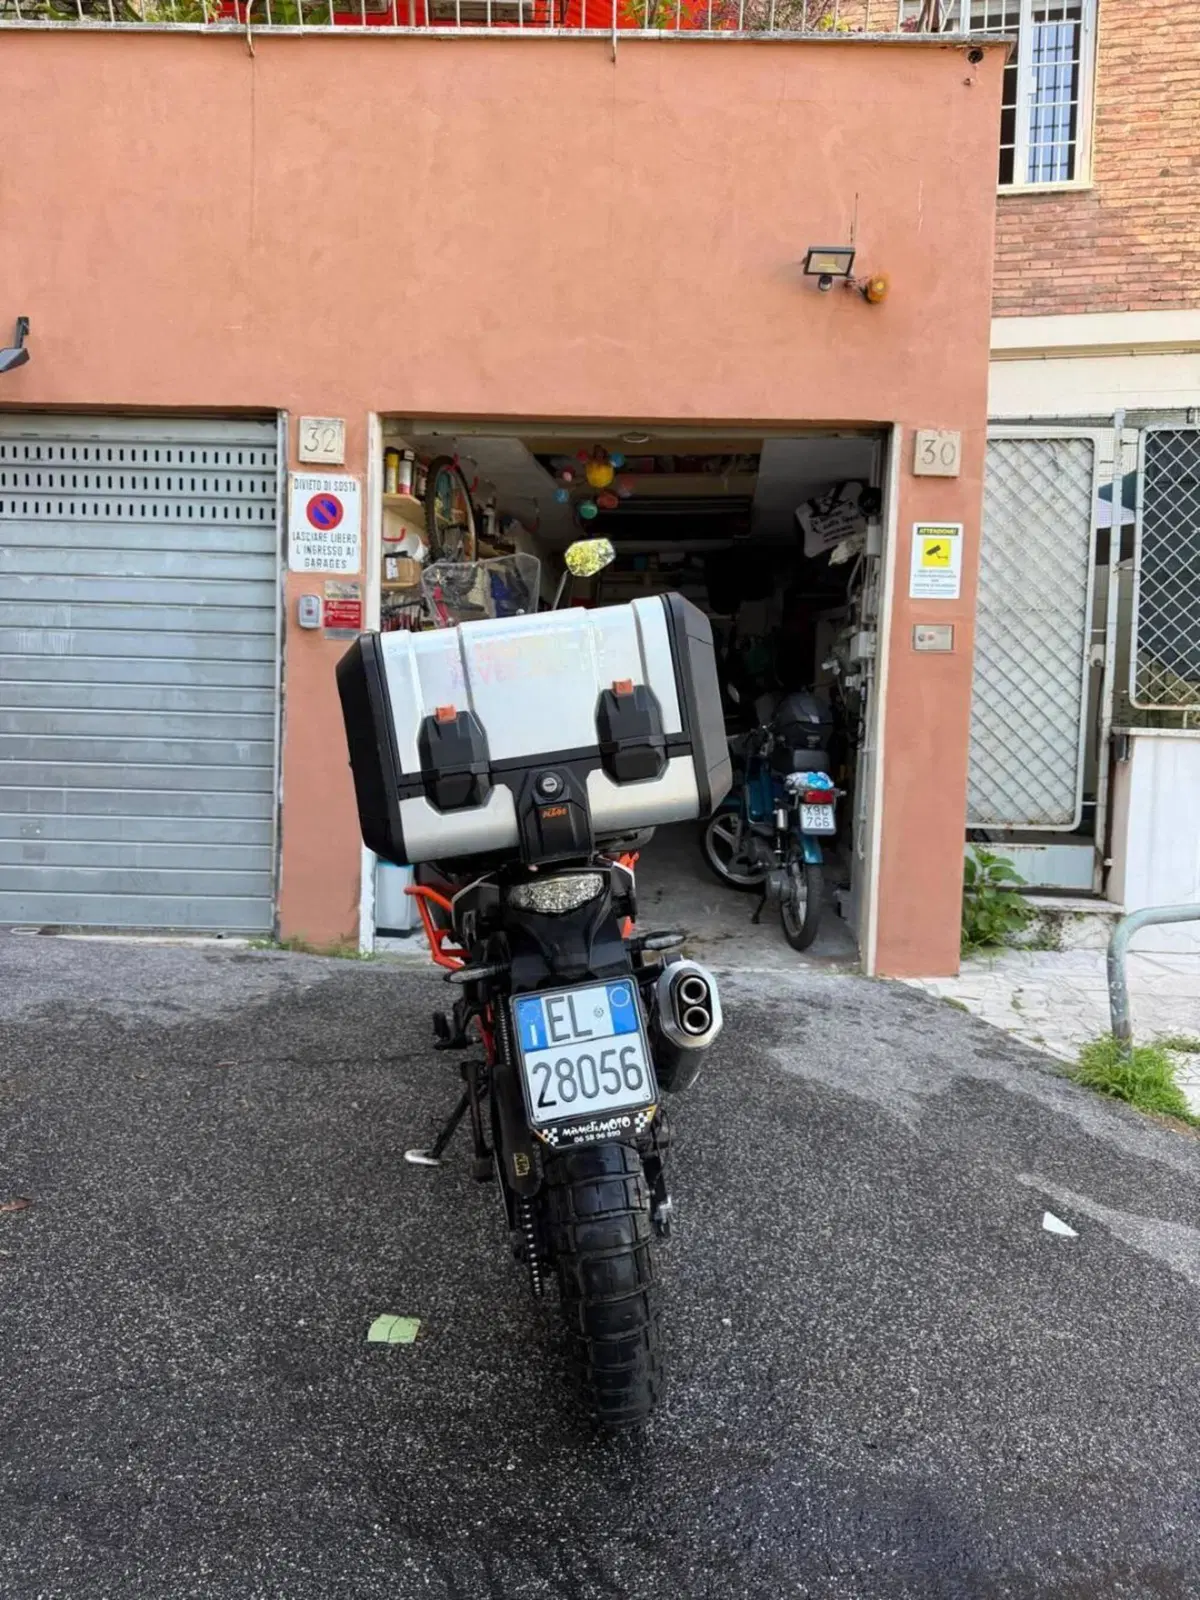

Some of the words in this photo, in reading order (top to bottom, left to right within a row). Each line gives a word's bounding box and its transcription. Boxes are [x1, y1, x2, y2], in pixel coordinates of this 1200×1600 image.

[304, 427, 336, 452] 32
[921, 439, 956, 466] 30
[294, 478, 321, 490] DIVIETO
[323, 480, 332, 491] DI
[334, 481, 356, 492] SOSTA
[292, 531, 328, 542] LASCIARE
[330, 533, 357, 543] LIBERO
[304, 558, 347, 569] GARAGES
[544, 995, 593, 1043] EL
[532, 1046, 643, 1108] 28056
